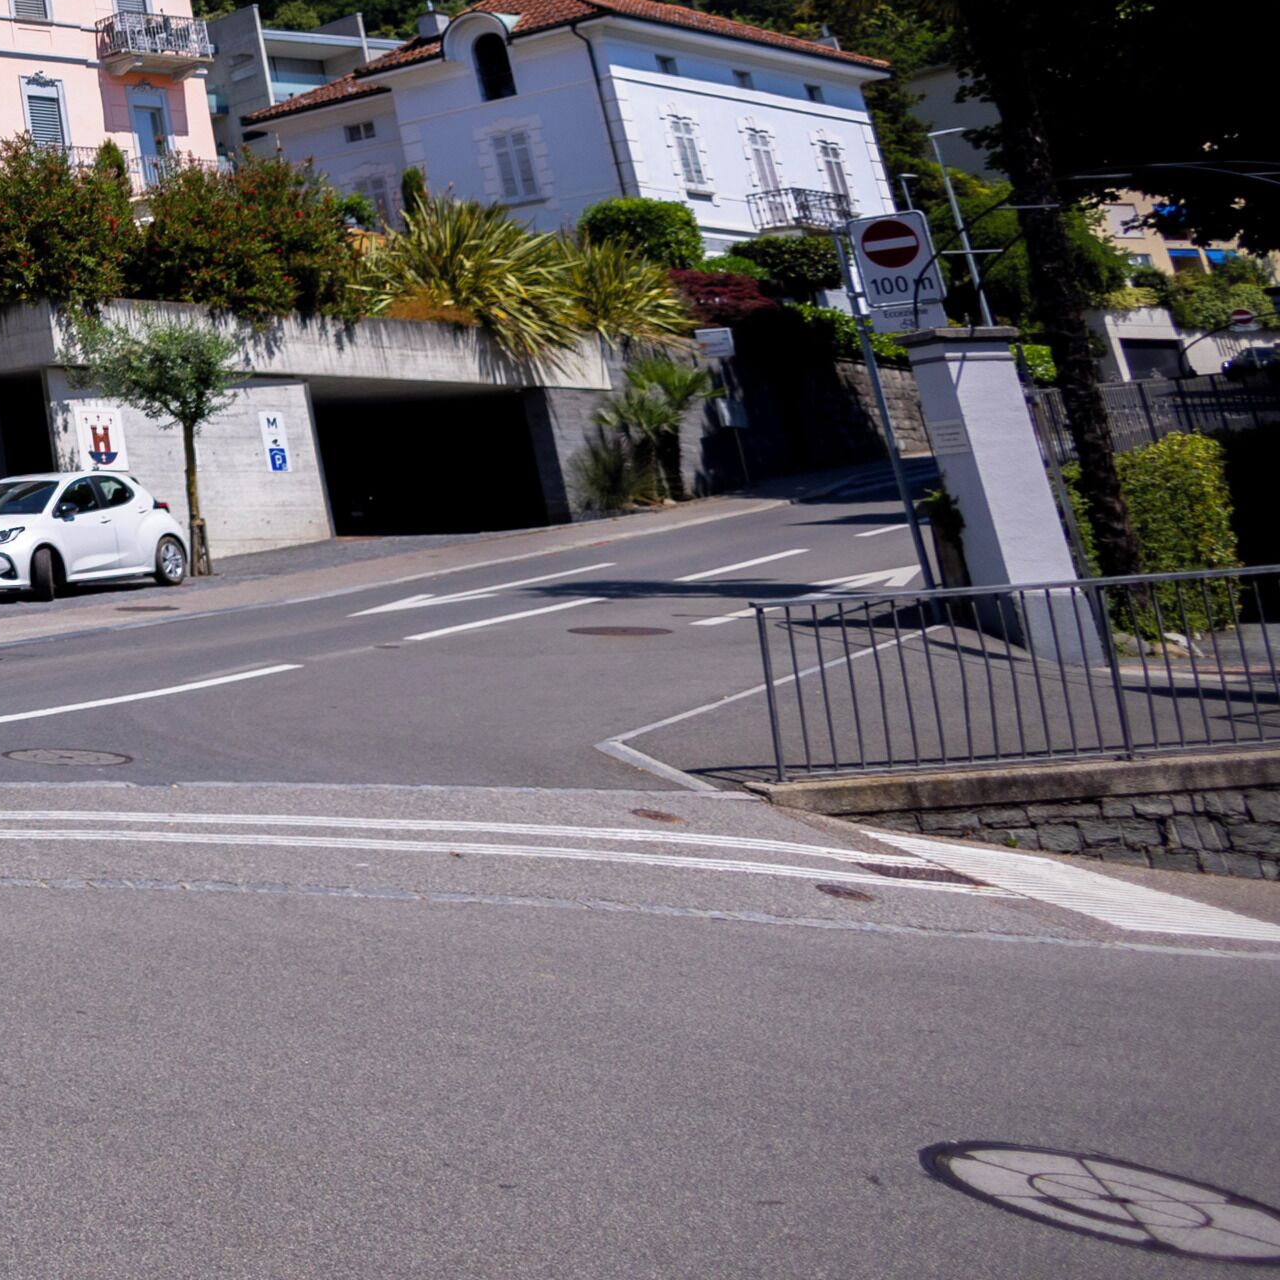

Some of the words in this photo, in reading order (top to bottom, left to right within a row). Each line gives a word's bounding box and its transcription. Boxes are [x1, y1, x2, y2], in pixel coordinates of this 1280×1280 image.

[870, 275, 908, 296] 100
[913, 276, 934, 292] m
[266, 417, 278, 429] M
